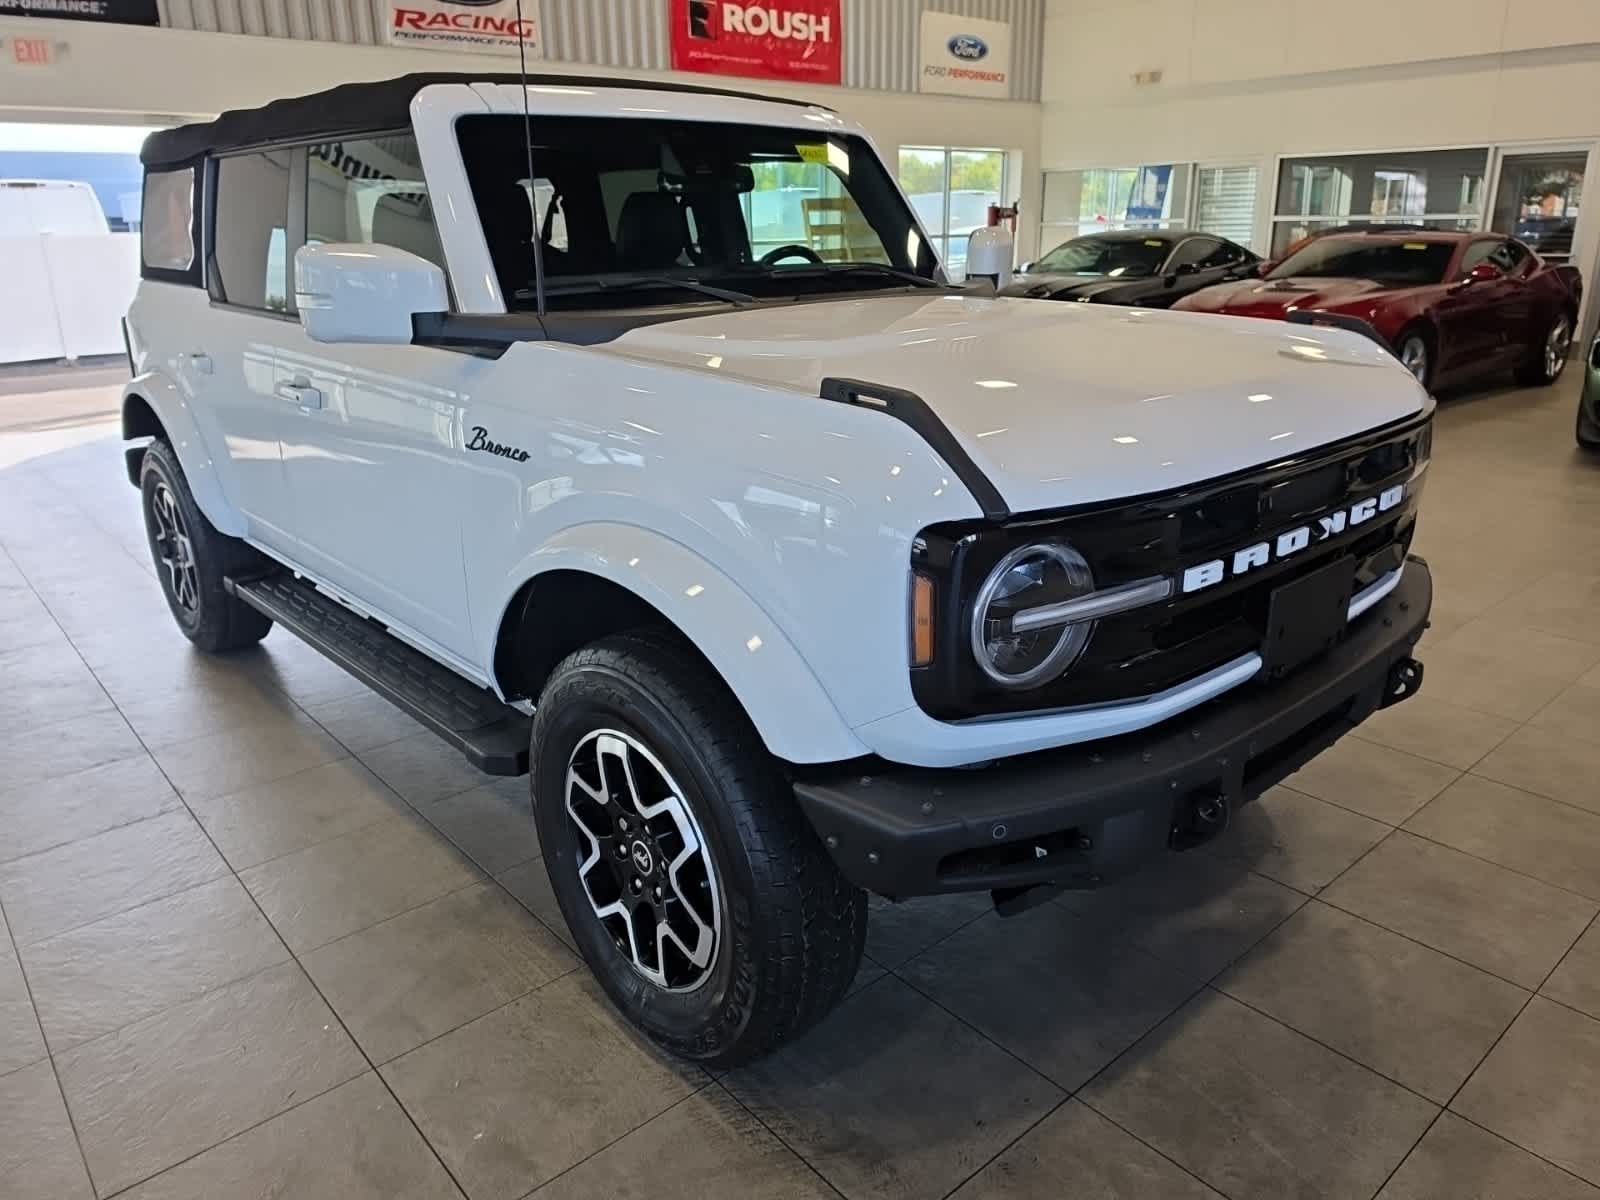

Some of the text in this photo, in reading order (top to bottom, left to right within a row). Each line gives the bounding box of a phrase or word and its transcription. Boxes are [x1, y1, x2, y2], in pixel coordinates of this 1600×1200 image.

[394, 8, 534, 38] RACING
[394, 31, 495, 45] PERFORMANCE
[722, 3, 830, 43] ROUSH
[14, 39, 48, 64] EXIT
[954, 39, 980, 57] Ford
[465, 426, 531, 462] Bronco
[1183, 485, 1403, 592] BRONCO
